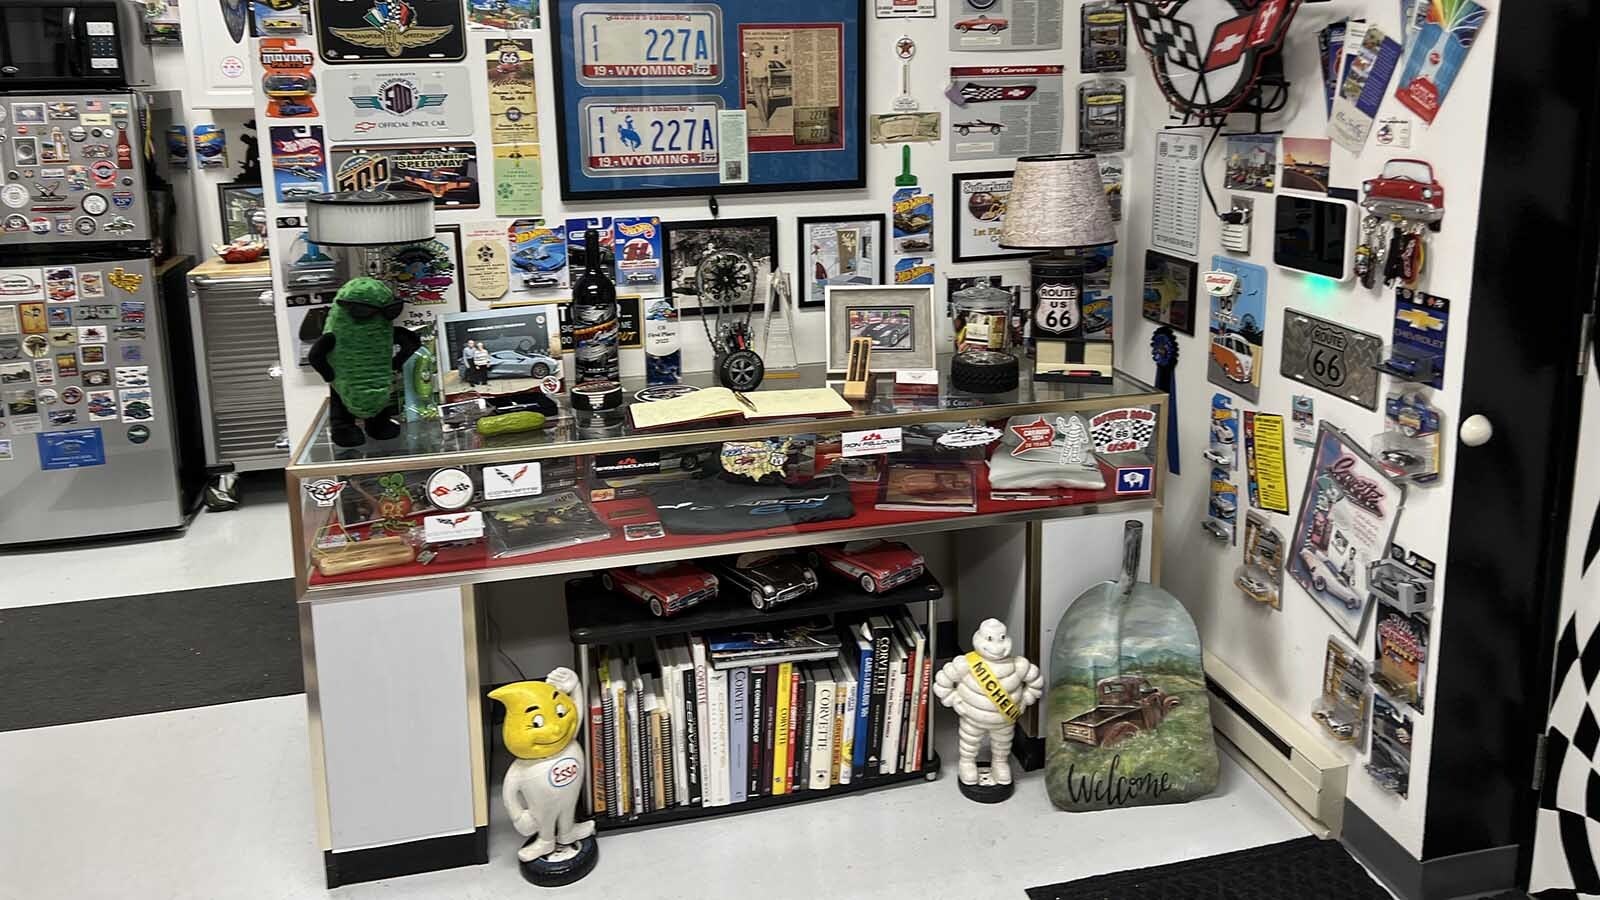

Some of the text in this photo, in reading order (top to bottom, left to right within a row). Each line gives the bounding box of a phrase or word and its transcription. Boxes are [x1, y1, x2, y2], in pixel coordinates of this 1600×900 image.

[644, 29, 708, 61] 227A
[502, 53, 517, 63] 66
[593, 66, 606, 76] 19
[616, 65, 688, 76] WYOMING
[651, 118, 714, 151] 227A
[397, 160, 463, 169] SPEEDWAY
[599, 158, 611, 167] 19
[620, 155, 688, 167] WYOMING
[1041, 289, 1076, 298] ROUTE
[1046, 311, 1071, 328] 66
[1315, 330, 1344, 347] ROUTE
[1394, 328, 1444, 348] CHEVROLET
[1313, 350, 1340, 381] 66
[863, 439, 901, 447] FELLOWS
[877, 637, 890, 694] CORVETTE
[734, 671, 746, 722] CORVETTE
[817, 689, 831, 752] CORVETTE
[1068, 754, 1172, 805] Welcome
